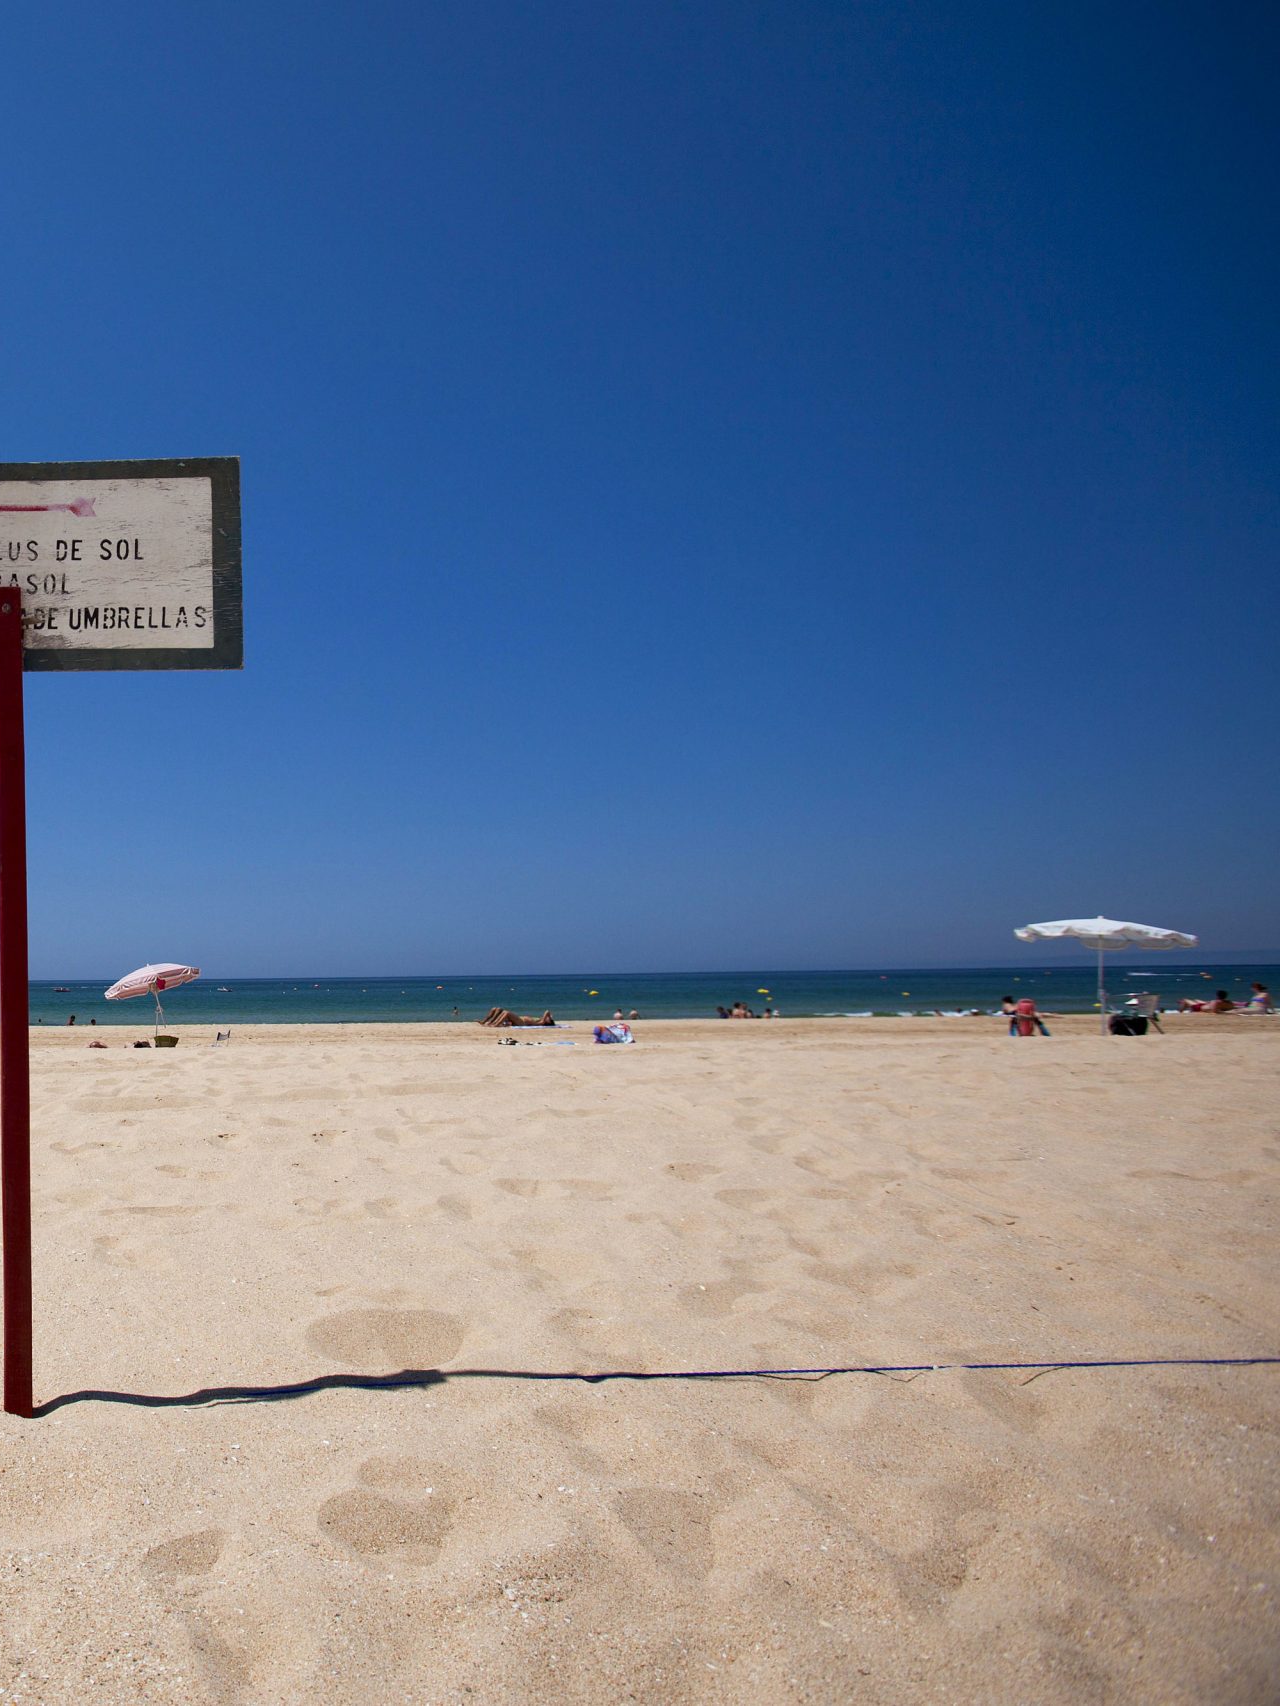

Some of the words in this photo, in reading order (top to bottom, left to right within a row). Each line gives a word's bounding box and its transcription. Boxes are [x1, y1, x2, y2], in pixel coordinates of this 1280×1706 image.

[56, 539, 83, 562] DE
[99, 538, 144, 561] SOL
[69, 605, 207, 630] UMBRELLAS
